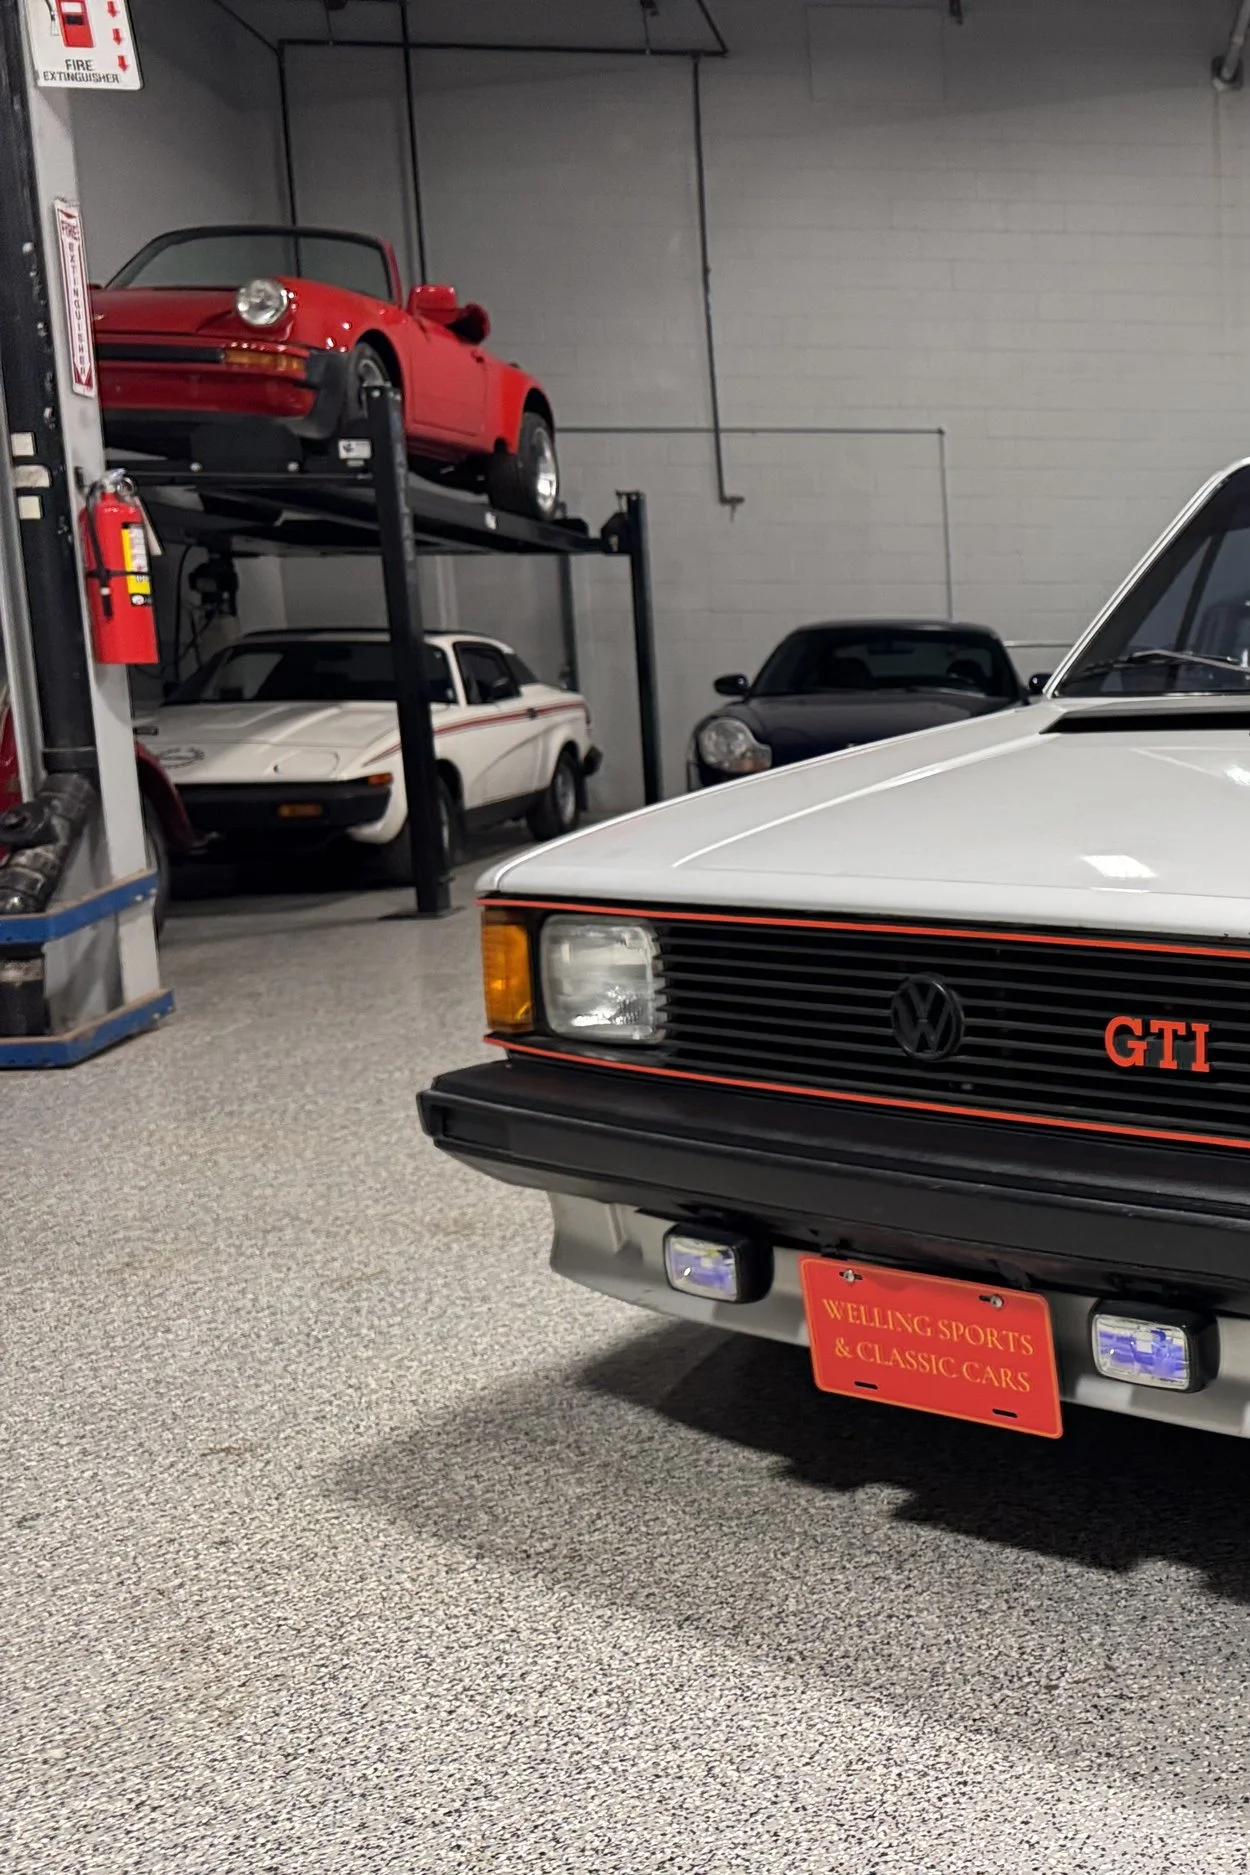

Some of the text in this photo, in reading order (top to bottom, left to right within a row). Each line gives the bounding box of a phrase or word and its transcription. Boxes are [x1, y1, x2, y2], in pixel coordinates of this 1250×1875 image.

[43, 71, 119, 83] EXTINGUISHER
[65, 59, 94, 71] FIRE
[1104, 1015, 1210, 1073] GTI
[821, 1298, 1034, 1356] WELLING SPORTS
[834, 1337, 1031, 1393] & CLASSIC CARS
